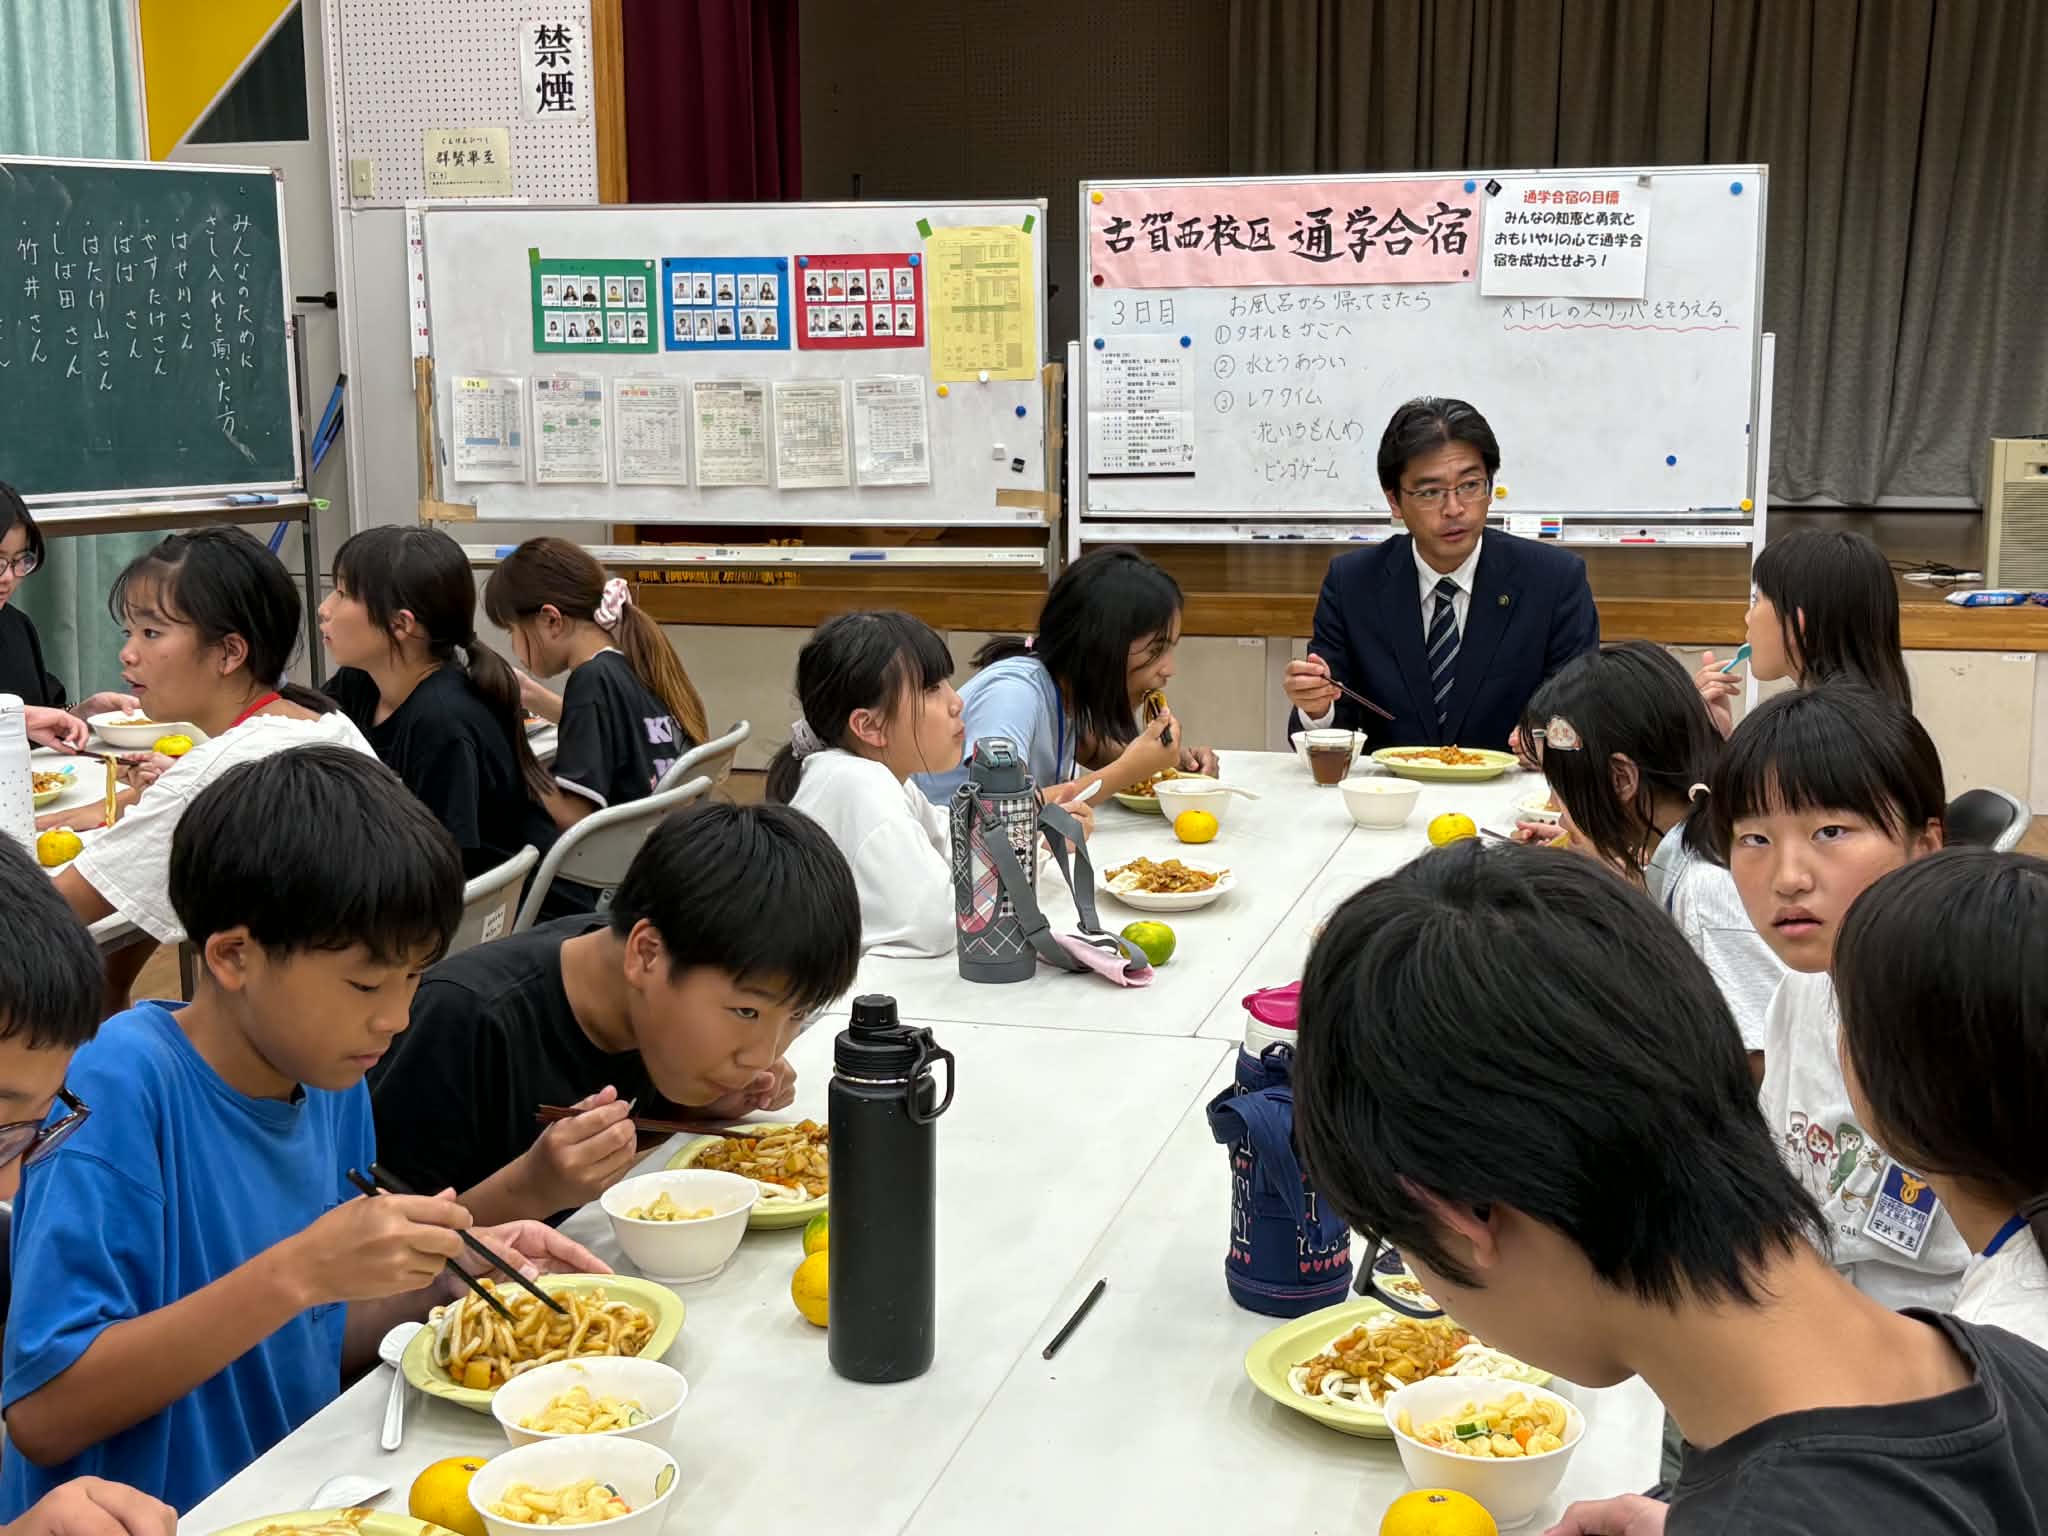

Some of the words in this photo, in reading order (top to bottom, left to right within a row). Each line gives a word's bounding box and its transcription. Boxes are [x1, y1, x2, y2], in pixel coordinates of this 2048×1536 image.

[533, 22, 576, 114] 禁煙
[1503, 210, 1636, 227] みんなの知恵と勇気と
[1522, 189, 1621, 206] 通学合宿の目標
[1101, 210, 1276, 257] 古賀西校区
[1287, 201, 1473, 264] 通学合宿
[1493, 231, 1644, 248] おもいやりの心で通学合
[1493, 252, 1608, 269] 宿を成功させよう！
[82, 235, 113, 391] はたけ山さん
[140, 233, 168, 376] やすたけさん
[171, 231, 194, 351] はせ川さん
[231, 213, 256, 369] みんなのために
[1111, 297, 1175, 326] 3日目
